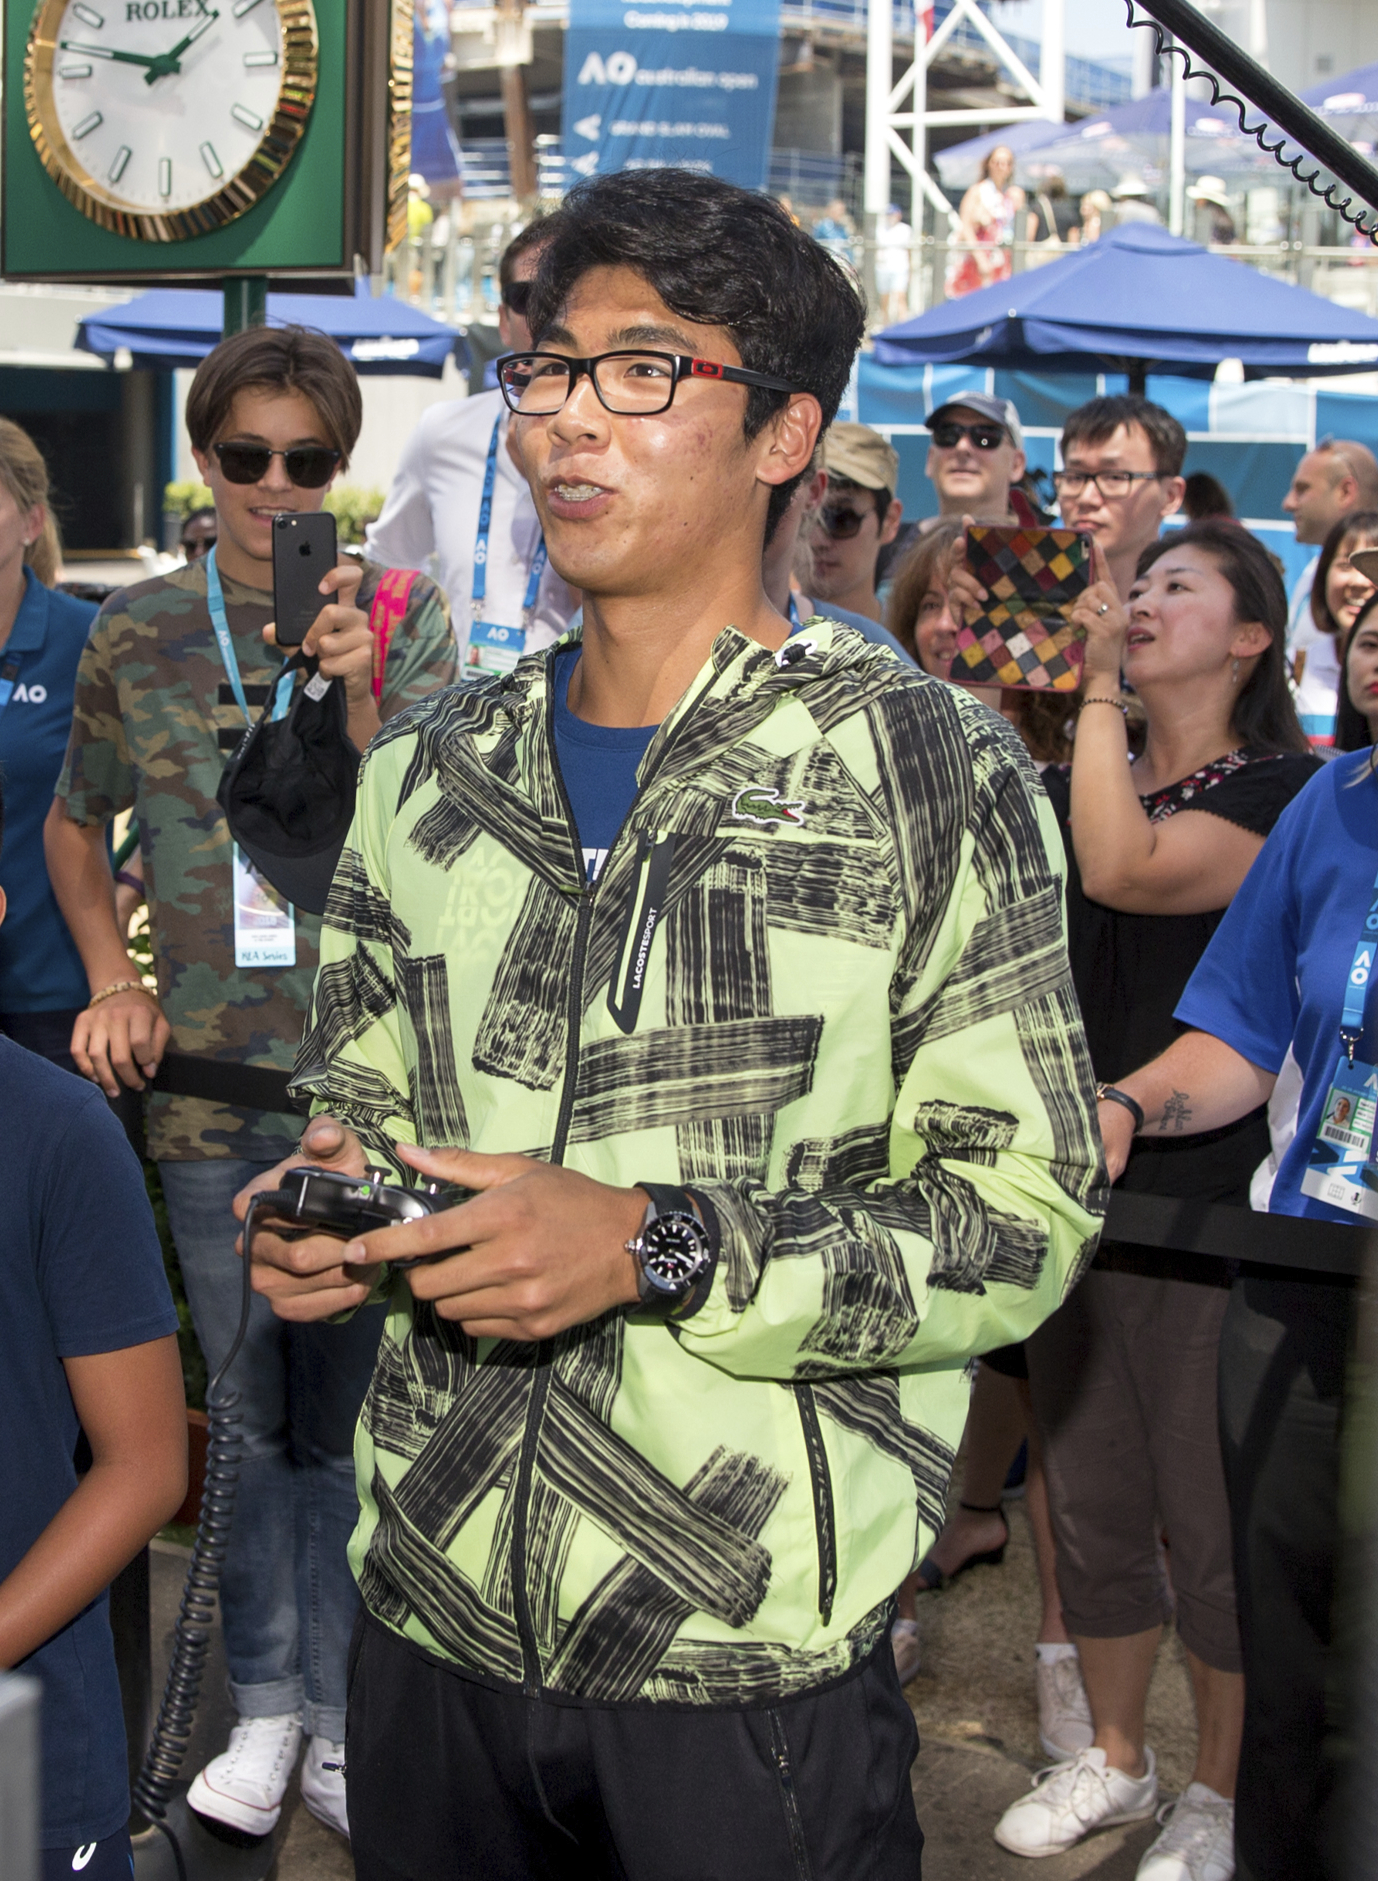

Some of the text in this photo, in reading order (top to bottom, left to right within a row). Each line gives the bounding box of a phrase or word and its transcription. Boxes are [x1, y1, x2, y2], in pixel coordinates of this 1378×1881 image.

[125, 0, 210, 21] ROLEX
[577, 50, 637, 86] AO
[474, 538, 487, 565] AO
[486, 626, 510, 641] AO
[12, 682, 47, 704] AO
[1350, 949, 1371, 985] AO
